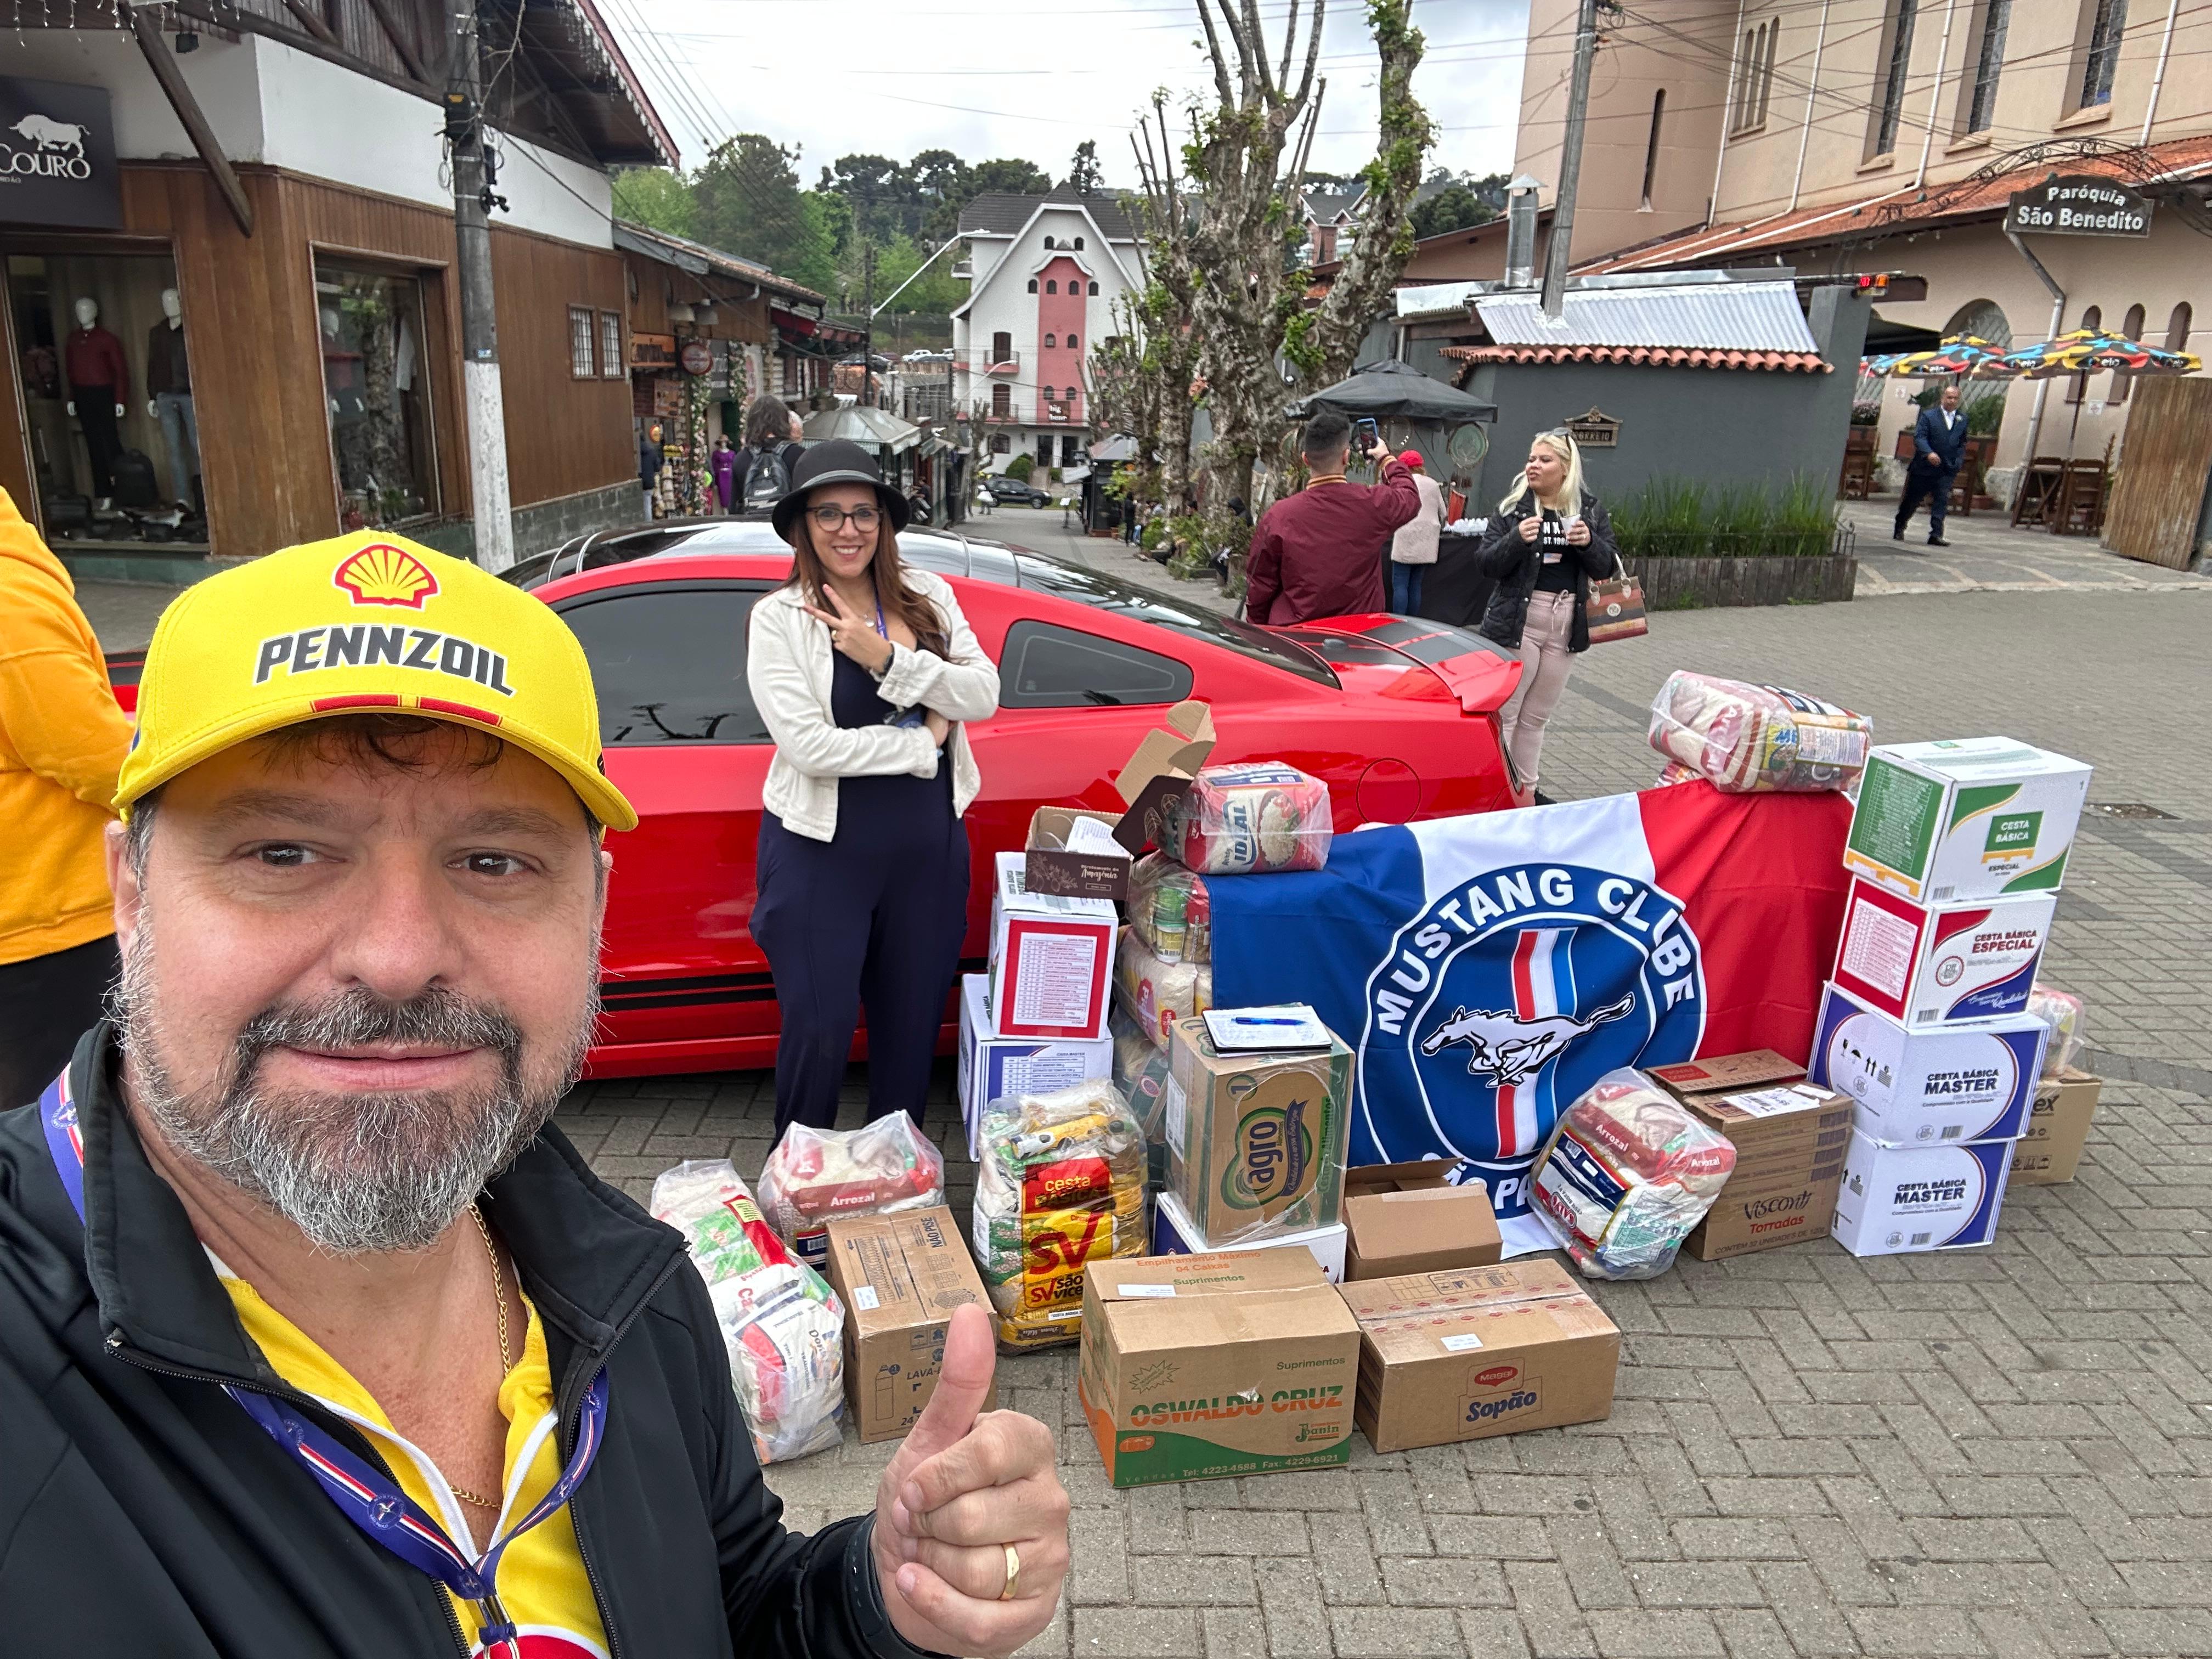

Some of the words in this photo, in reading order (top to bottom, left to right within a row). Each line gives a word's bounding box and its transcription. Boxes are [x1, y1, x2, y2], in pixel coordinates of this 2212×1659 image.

[2047, 184, 2126, 206] Paróquia
[2017, 205, 2054, 225] São
[2058, 208, 2143, 229] Benedito
[255, 624, 515, 697] PENNZOIL
[2000, 820, 2030, 831] CESTA
[1995, 831, 2029, 843] BÁSICA
[1988, 863, 2020, 872] ESPECIAL
[1975, 933, 2003, 942] CESTA
[2005, 929, 2037, 940] BÁSICA
[1377, 868, 1574, 1035] MUSTANG
[1972, 939, 2035, 953] ESPECIAL
[1927, 1072, 1960, 1082] CESTA
[1962, 1069, 1999, 1079] BÁSICA
[1924, 1077, 1997, 1095] MASTER
[2033, 1094, 2059, 1112] ex
[1595, 1124, 1629, 1152] Arrozal
[1248, 1121, 1284, 1184] agro
[1045, 1175, 1091, 1192] cesta
[1897, 1182, 1929, 1192] CESTA
[1931, 1179, 1967, 1188] BÁSICA
[830, 1192, 876, 1206] Arrozal
[1894, 1187, 1965, 1205] MASTER
[1745, 1190, 1812, 1220] Visconti
[921, 1216, 937, 1232] PISE
[1750, 1215, 1805, 1234] Torradas
[928, 1231, 943, 1248] NÃO
[1029, 1211, 1104, 1274] SV
[1759, 1233, 1794, 1246] UNIDADES
[1137, 1255, 1216, 1267] Empilhamento
[1218, 1251, 1261, 1260] Máximo
[1192, 1262, 1230, 1272] Caixas
[1031, 1277, 1058, 1302] SV
[1056, 1273, 1084, 1290] são
[1173, 1274, 1245, 1286] Suprimentos
[1053, 1287, 1084, 1300] vice
[1276, 1357, 1346, 1371] Suprimentos
[1480, 1369, 1513, 1381] Maggi
[1130, 1395, 1265, 1427] OSWALDO
[1271, 1384, 1344, 1414] CRUZ
[1466, 1390, 1537, 1423] Sopão
[901, 1417, 913, 1426] 24
[1183, 1469, 1199, 1477] Tel:
[1262, 1460, 1282, 1469] Fax:
[1284, 1454, 1339, 1466] 4229-6921
